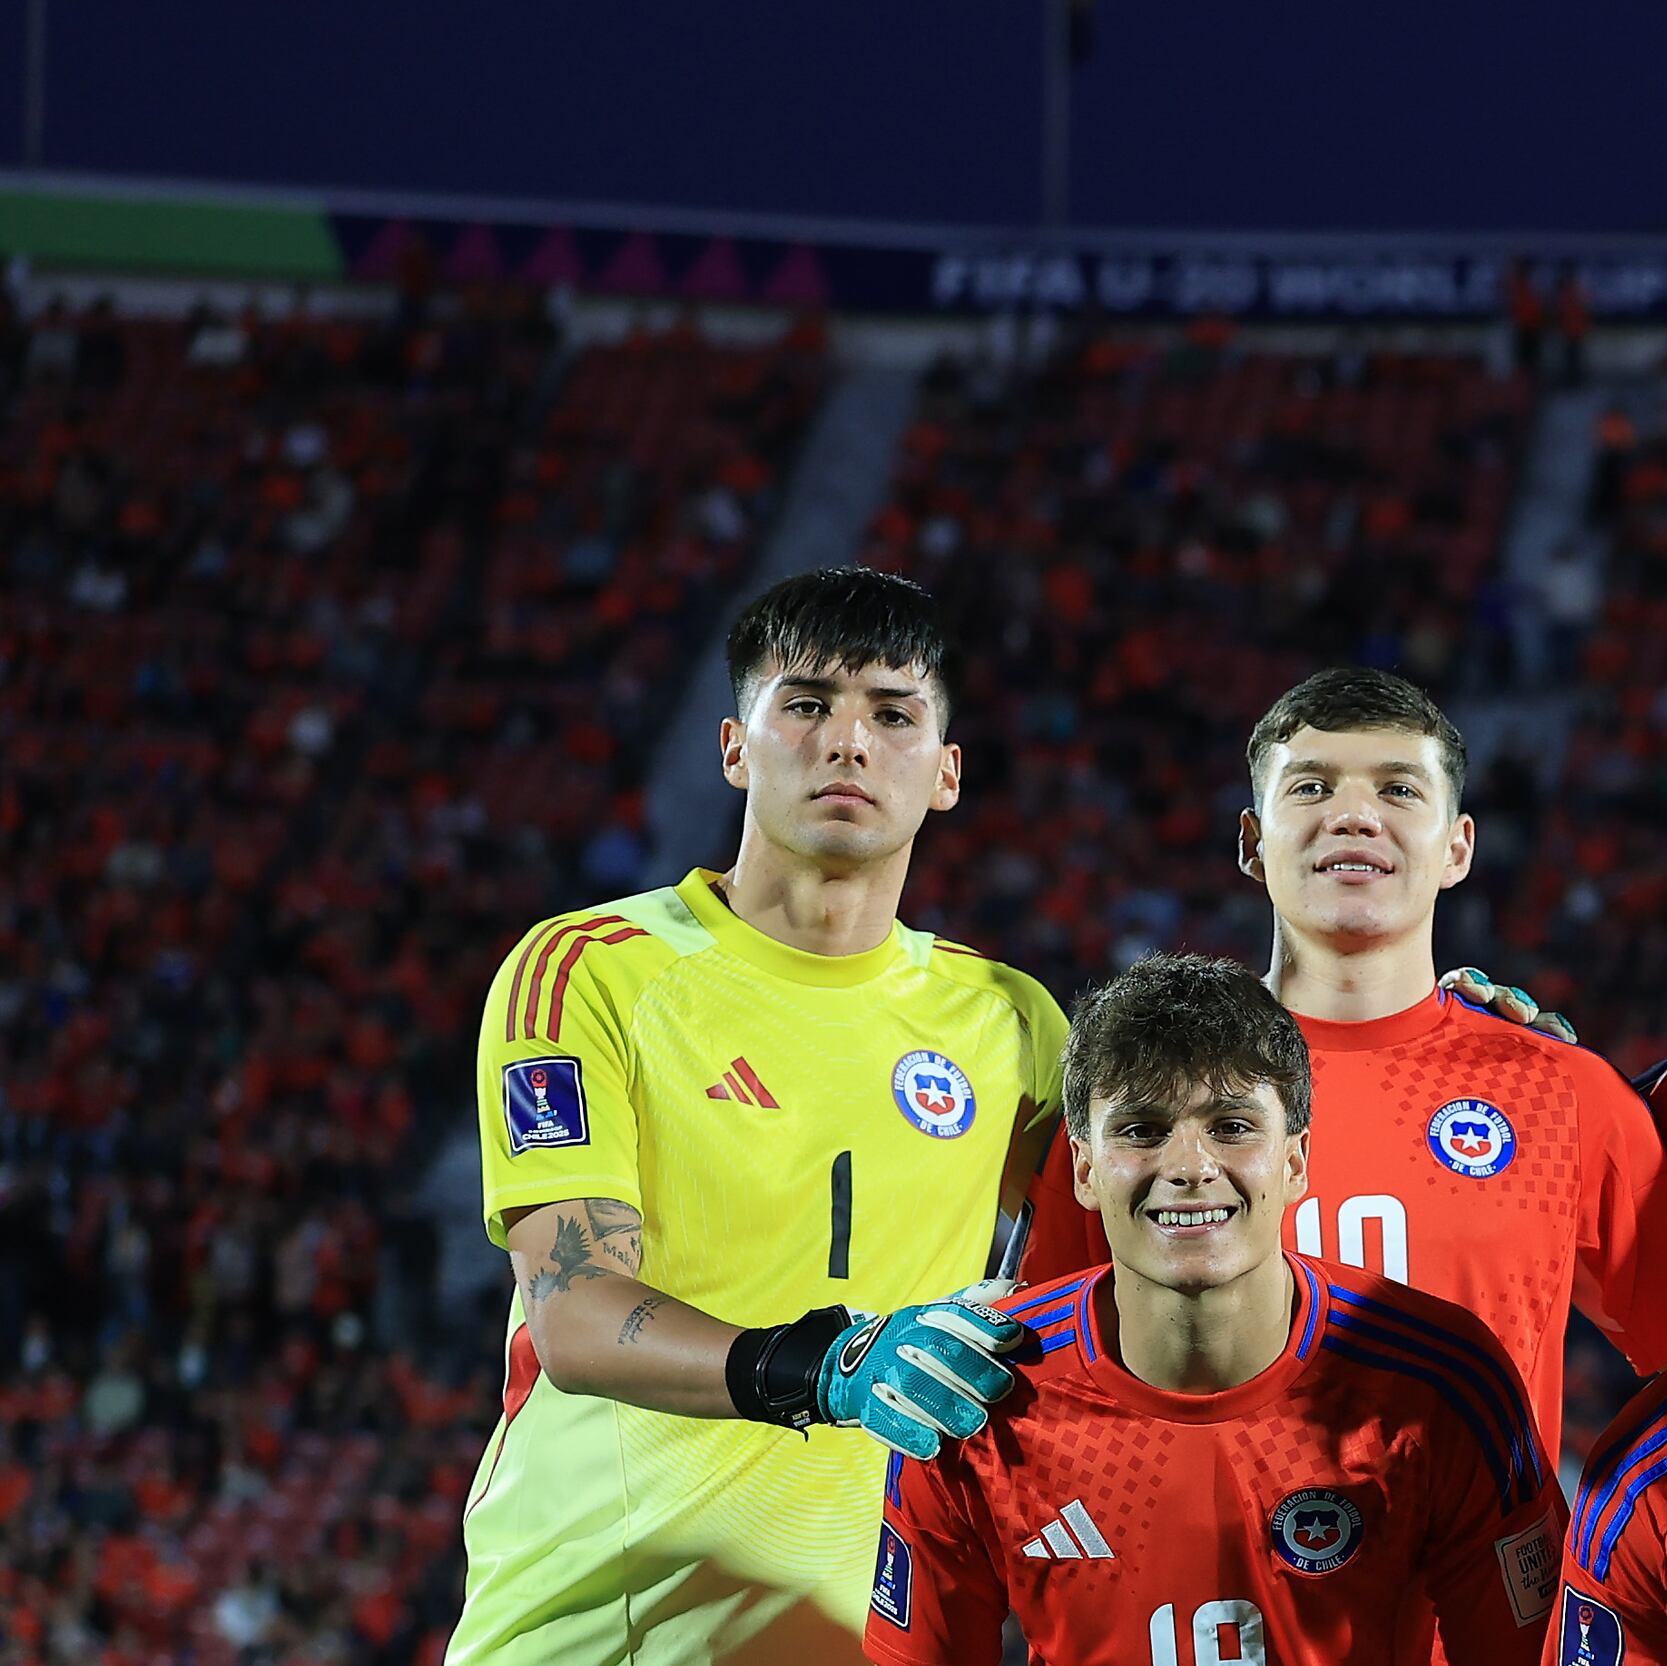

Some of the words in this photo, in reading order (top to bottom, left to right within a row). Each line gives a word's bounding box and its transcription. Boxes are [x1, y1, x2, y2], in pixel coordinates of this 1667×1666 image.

[1430, 1101, 1469, 1136] FEDERACION
[1475, 1102, 1488, 1113] DE
[1451, 1162, 1464, 1173] DE
[1469, 1163, 1495, 1177] CHILE
[827, 1150, 852, 1280] 1
[1272, 1491, 1316, 1530] FEDERACION
[1324, 1492, 1336, 1502] DE
[1296, 1559, 1309, 1570] DE
[1315, 1557, 1345, 1571] CHILE
